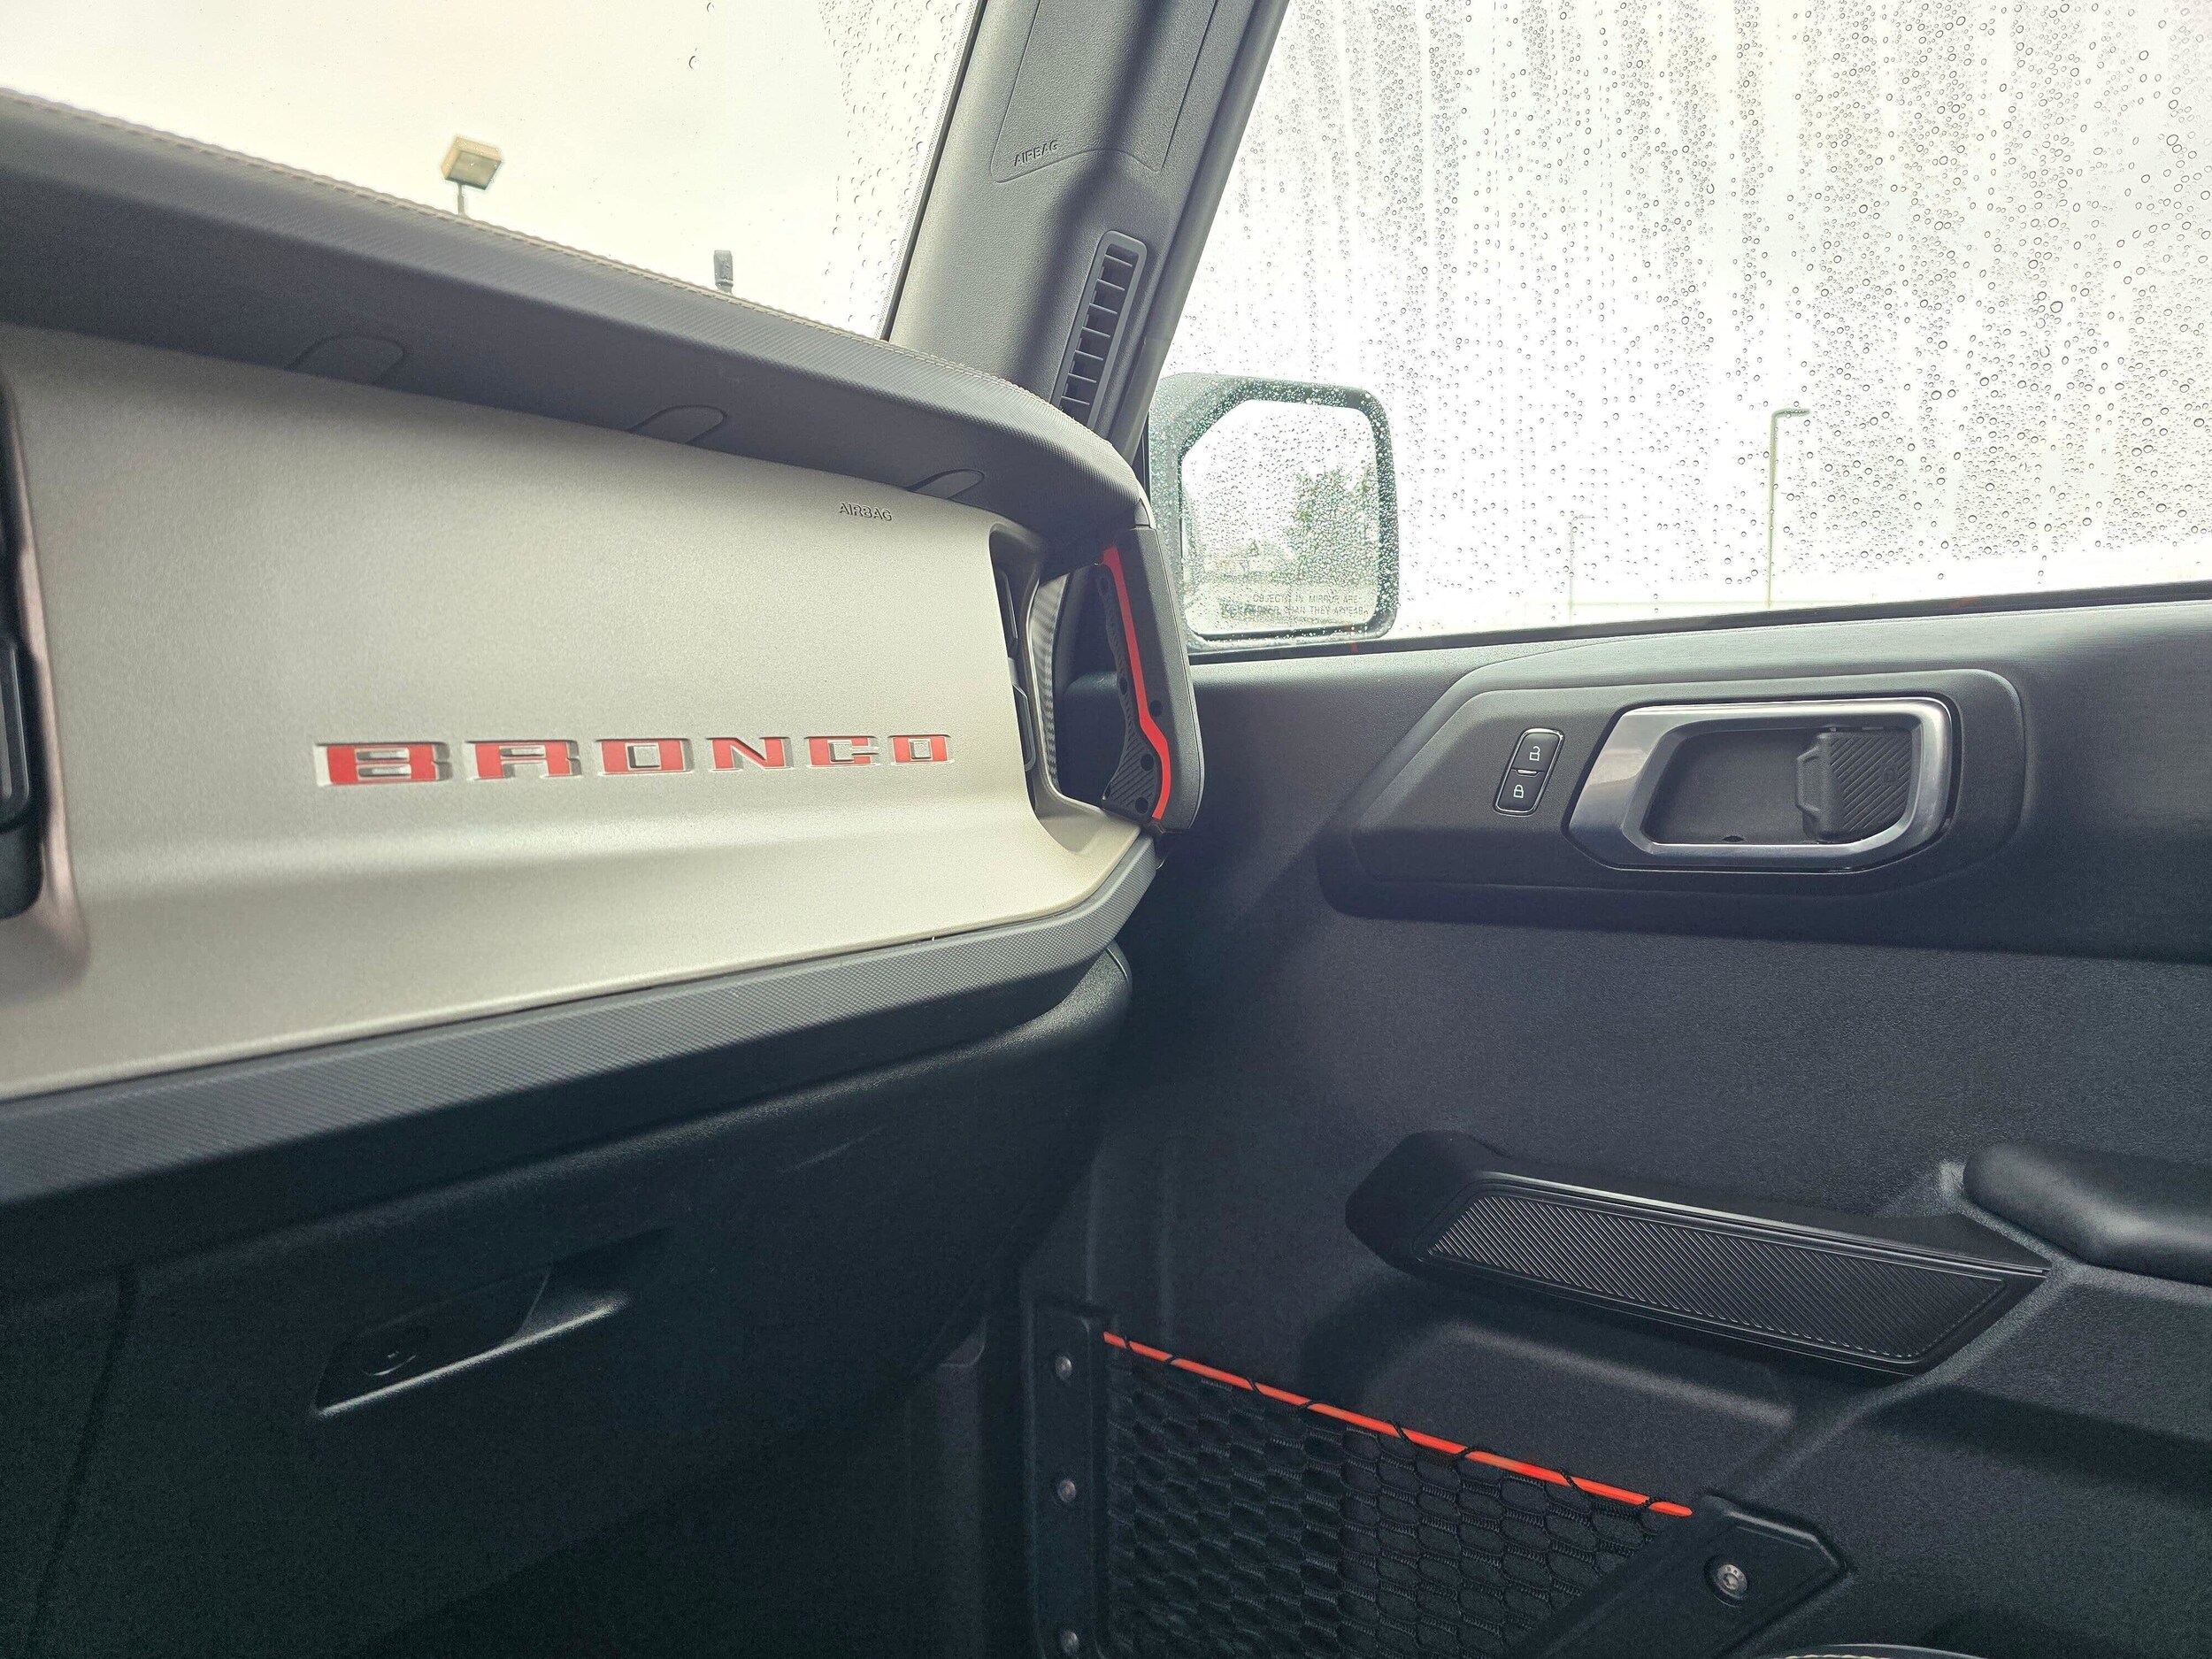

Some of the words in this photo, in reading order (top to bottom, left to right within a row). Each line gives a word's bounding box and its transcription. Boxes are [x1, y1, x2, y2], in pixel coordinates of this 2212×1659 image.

[1013, 140, 1058, 166] AIRBAG
[839, 501, 893, 521] AIRBAG
[313, 733, 955, 786] BRONCO
